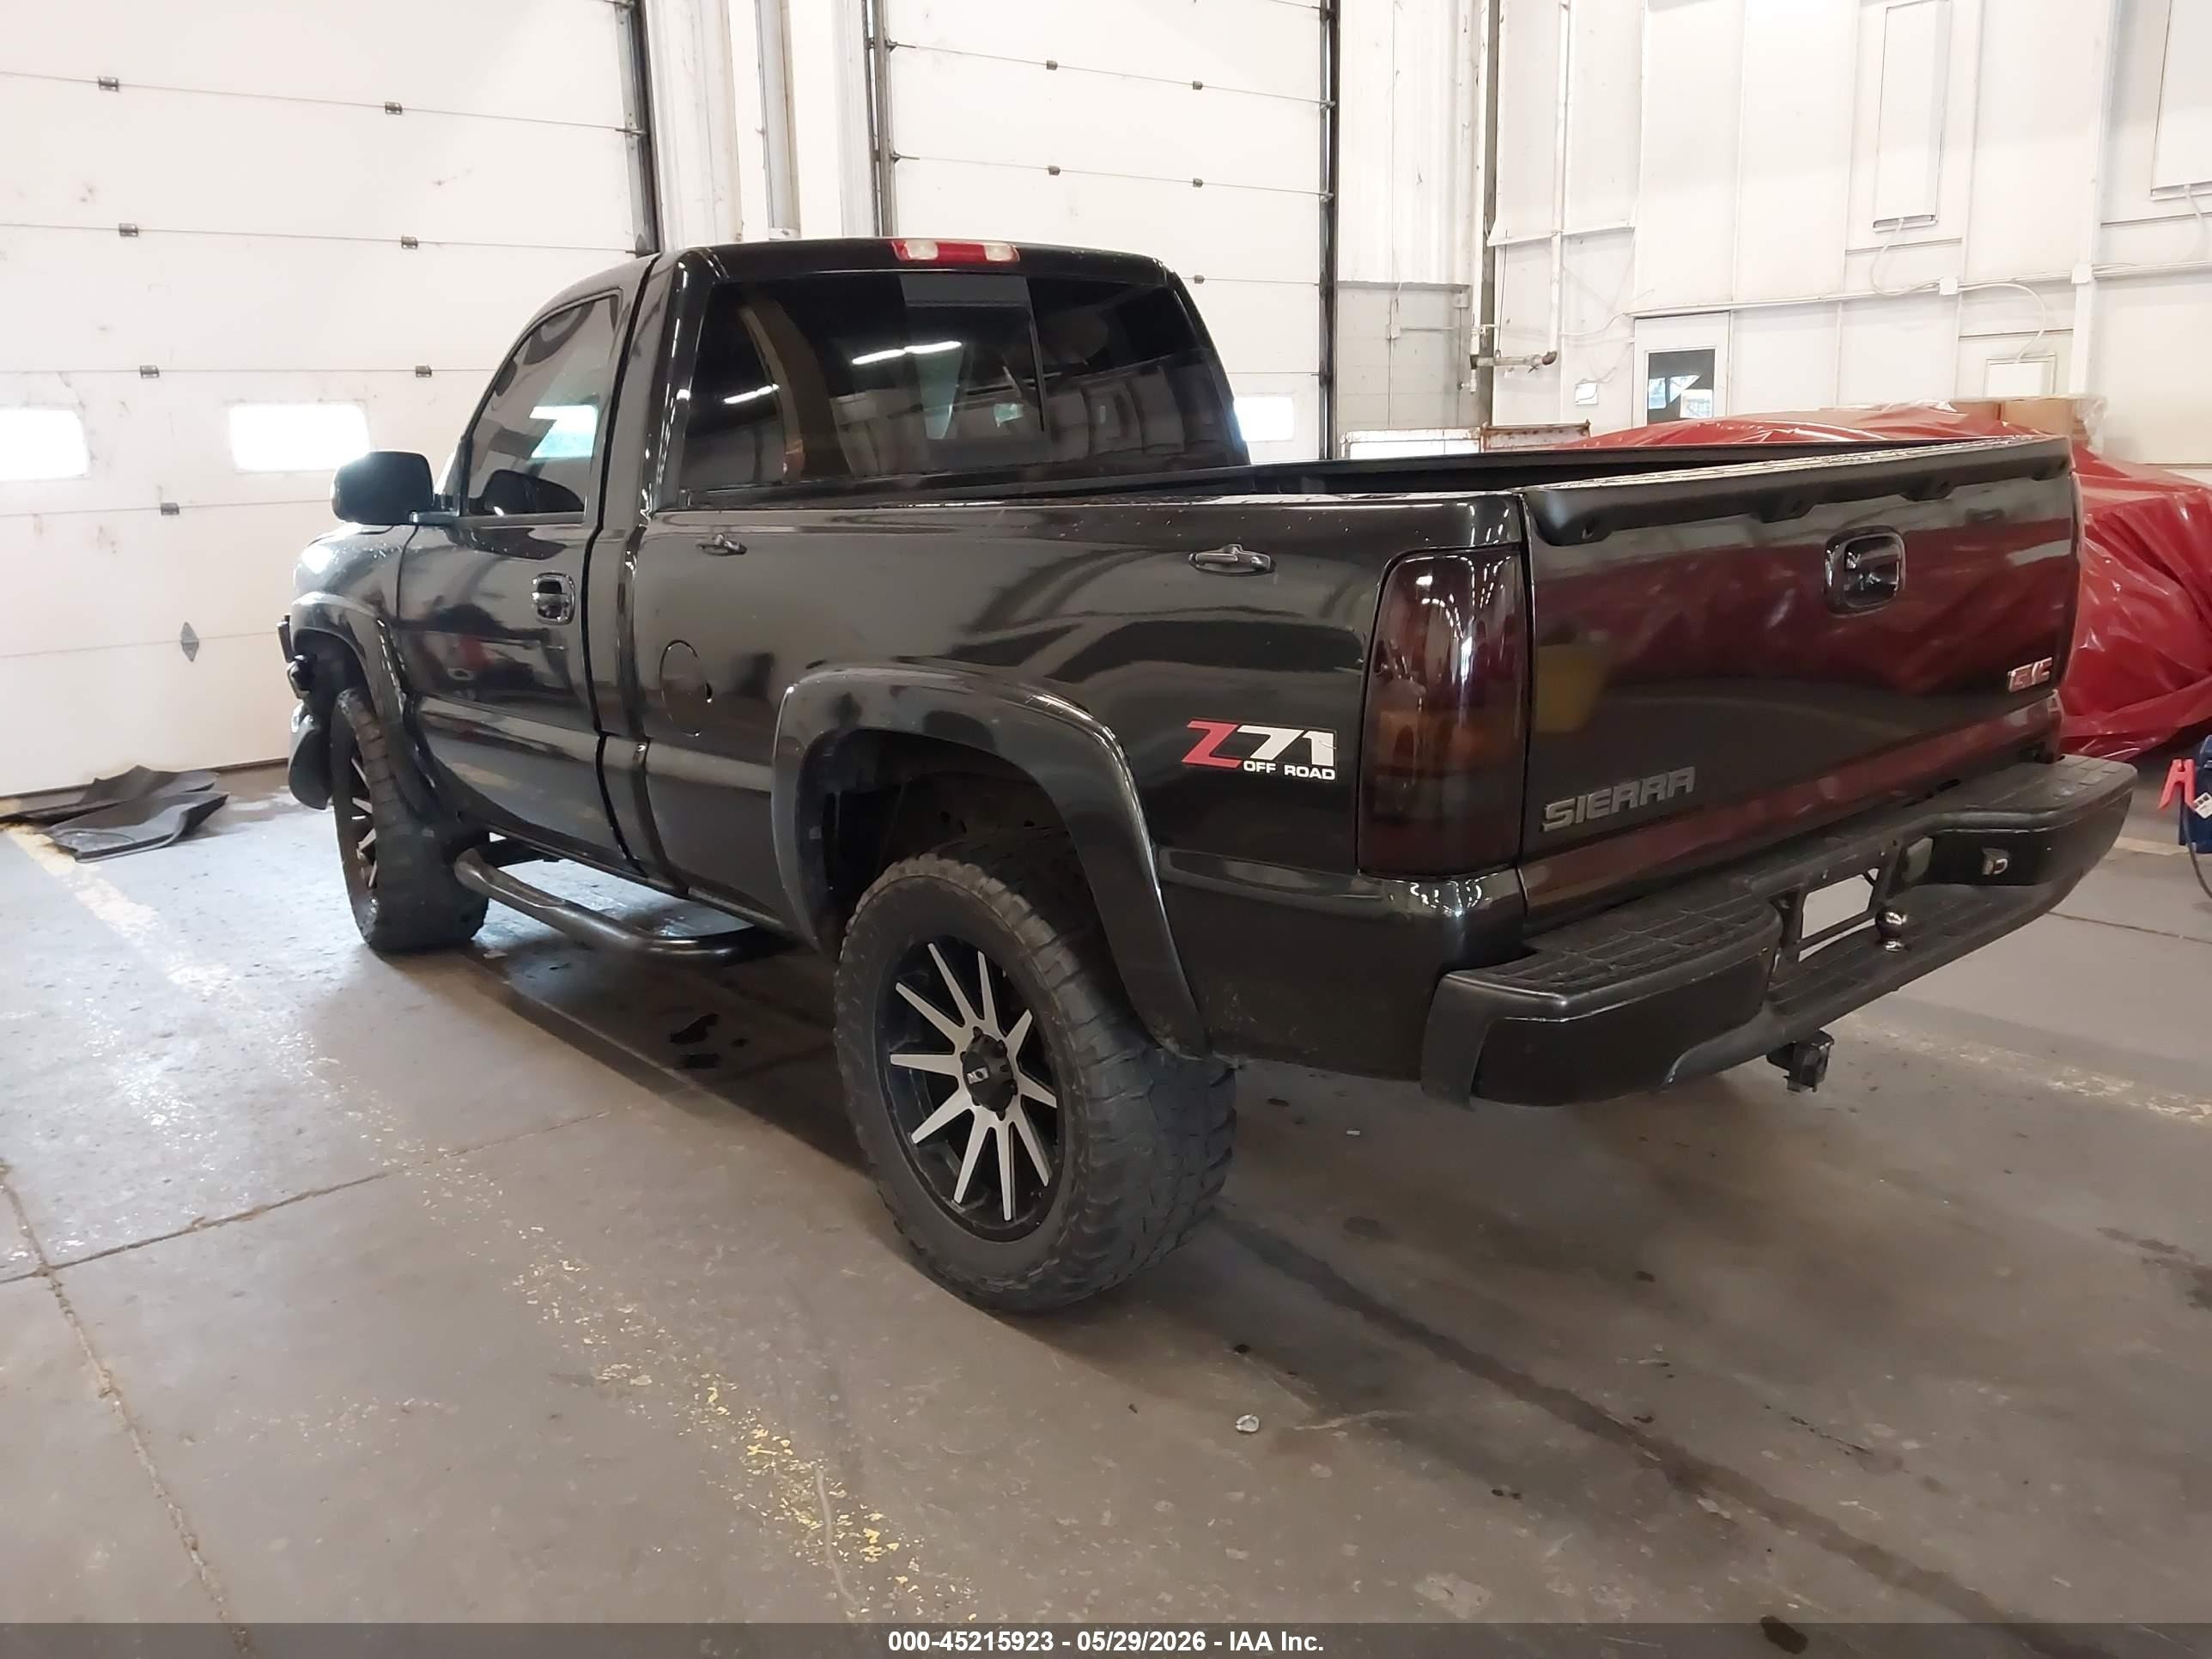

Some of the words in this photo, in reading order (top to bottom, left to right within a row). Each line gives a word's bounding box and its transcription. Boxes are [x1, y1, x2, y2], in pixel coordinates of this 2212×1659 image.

[1182, 720, 1334, 769] Z71
[1243, 760, 1277, 774] OFF
[1284, 765, 1336, 781] ROAD
[1542, 765, 1696, 833] SIERRA
